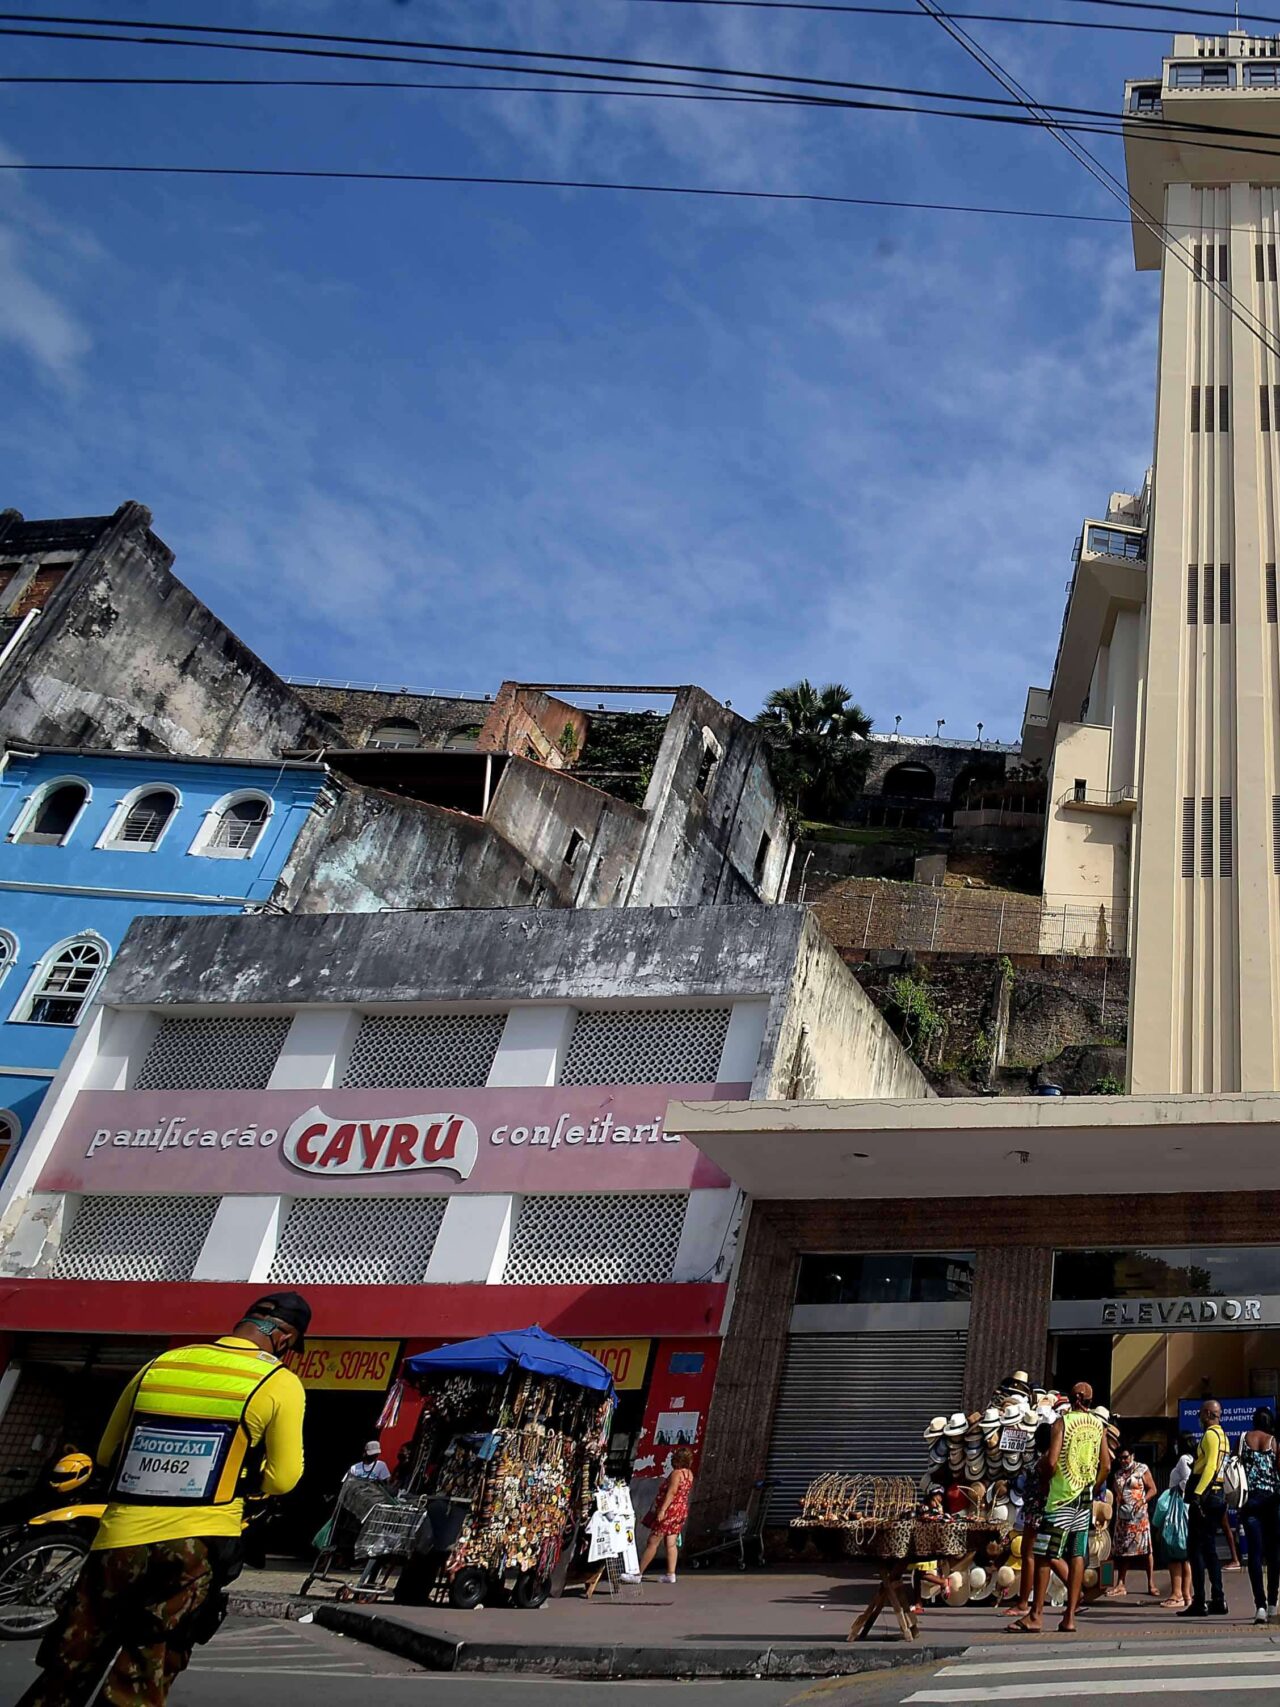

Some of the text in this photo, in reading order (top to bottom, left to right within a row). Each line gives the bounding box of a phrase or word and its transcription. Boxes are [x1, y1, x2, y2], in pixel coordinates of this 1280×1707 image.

[86, 1117, 278, 1157] panificação
[296, 1114, 464, 1169] CAYRÚ
[1102, 1299, 1261, 1324] ELEVADOR
[335, 1351, 390, 1380] SOPAS
[140, 1440, 206, 1454] MOTOTÁXI
